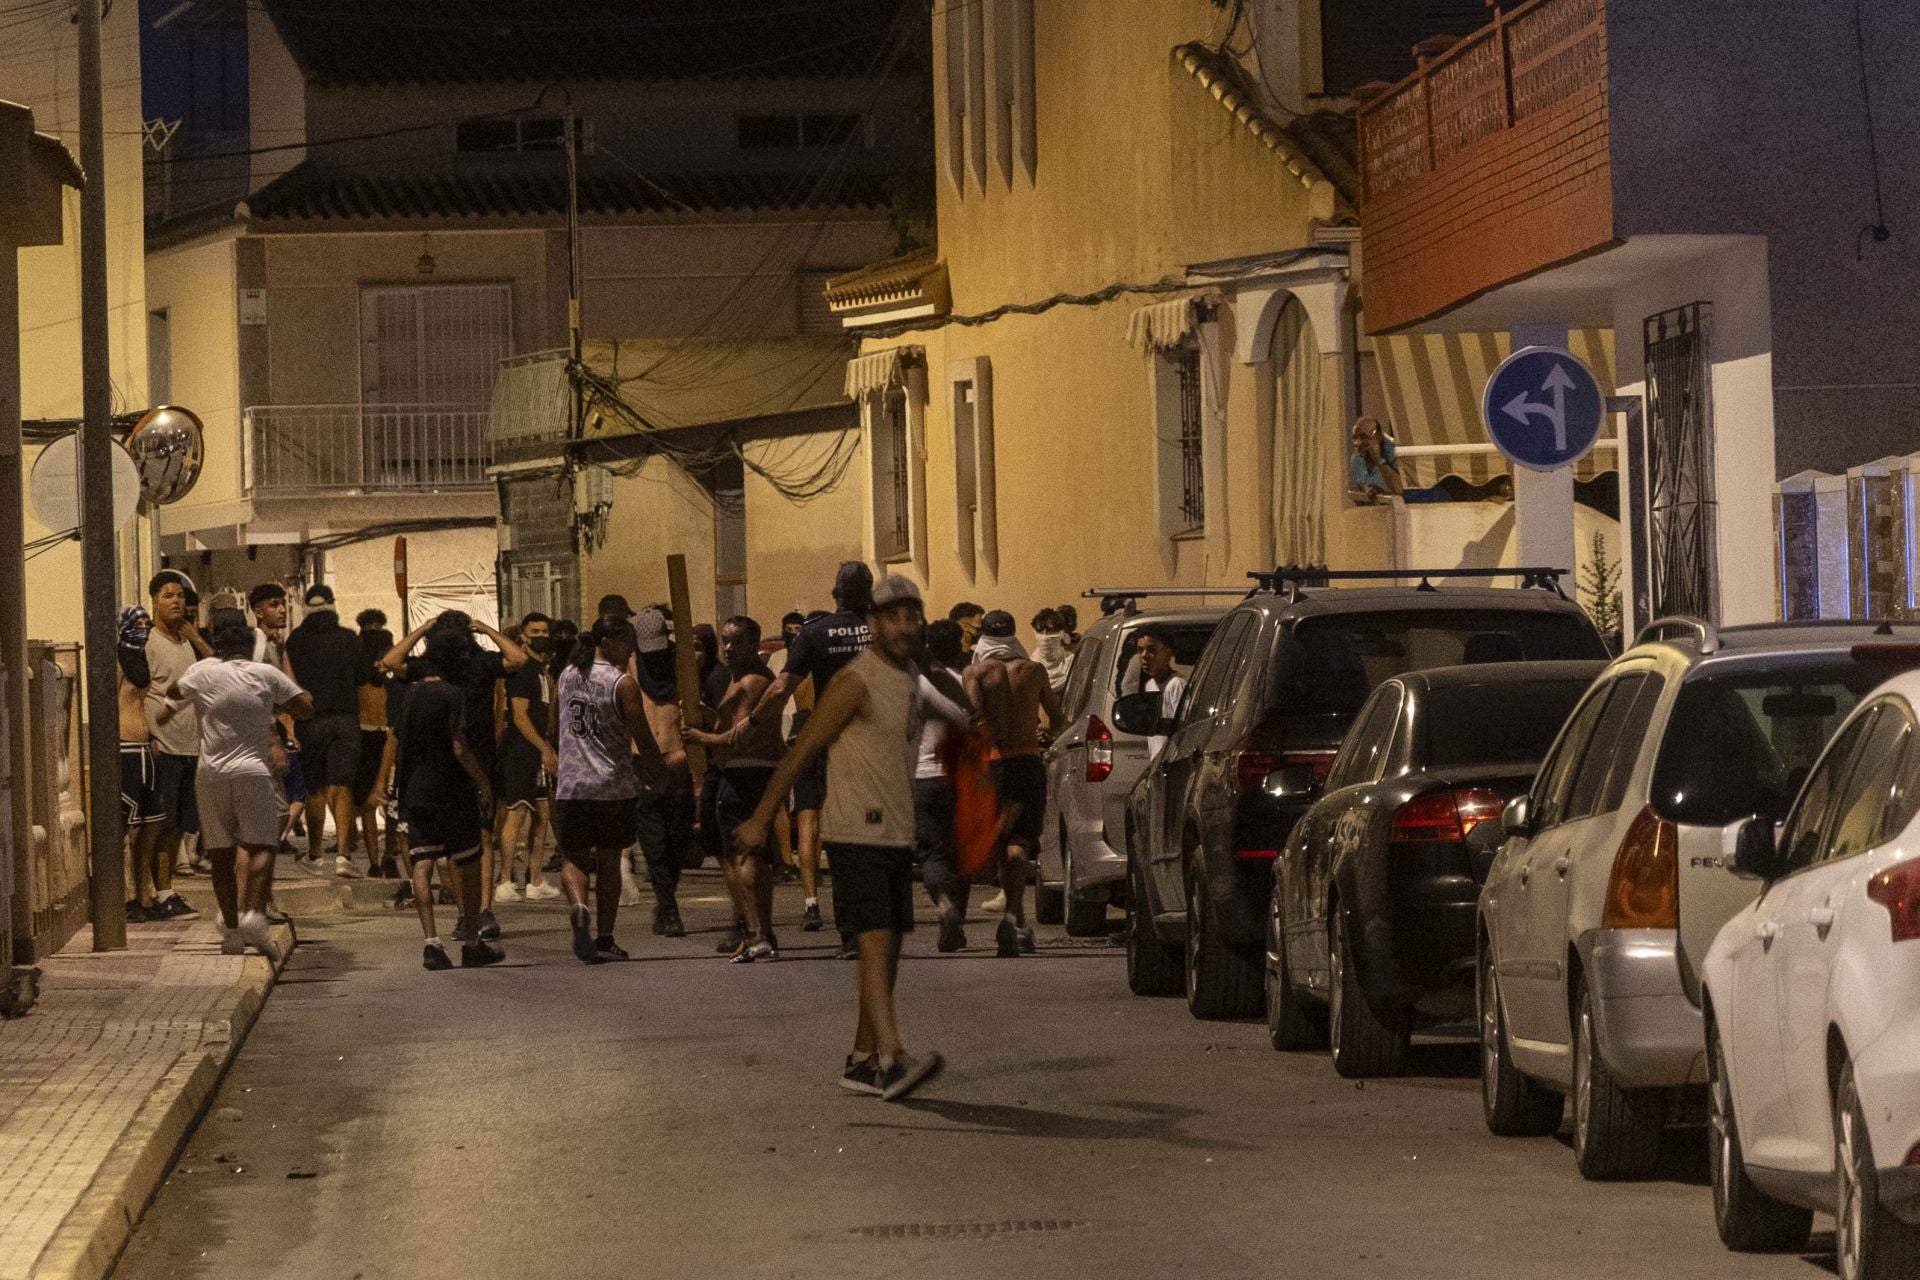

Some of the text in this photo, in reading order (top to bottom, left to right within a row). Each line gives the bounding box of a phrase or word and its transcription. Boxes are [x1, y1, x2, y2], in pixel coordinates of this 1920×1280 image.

[828, 625, 869, 637] POLIC
[857, 634, 873, 643] LOC
[1690, 857, 1723, 868] PEU
